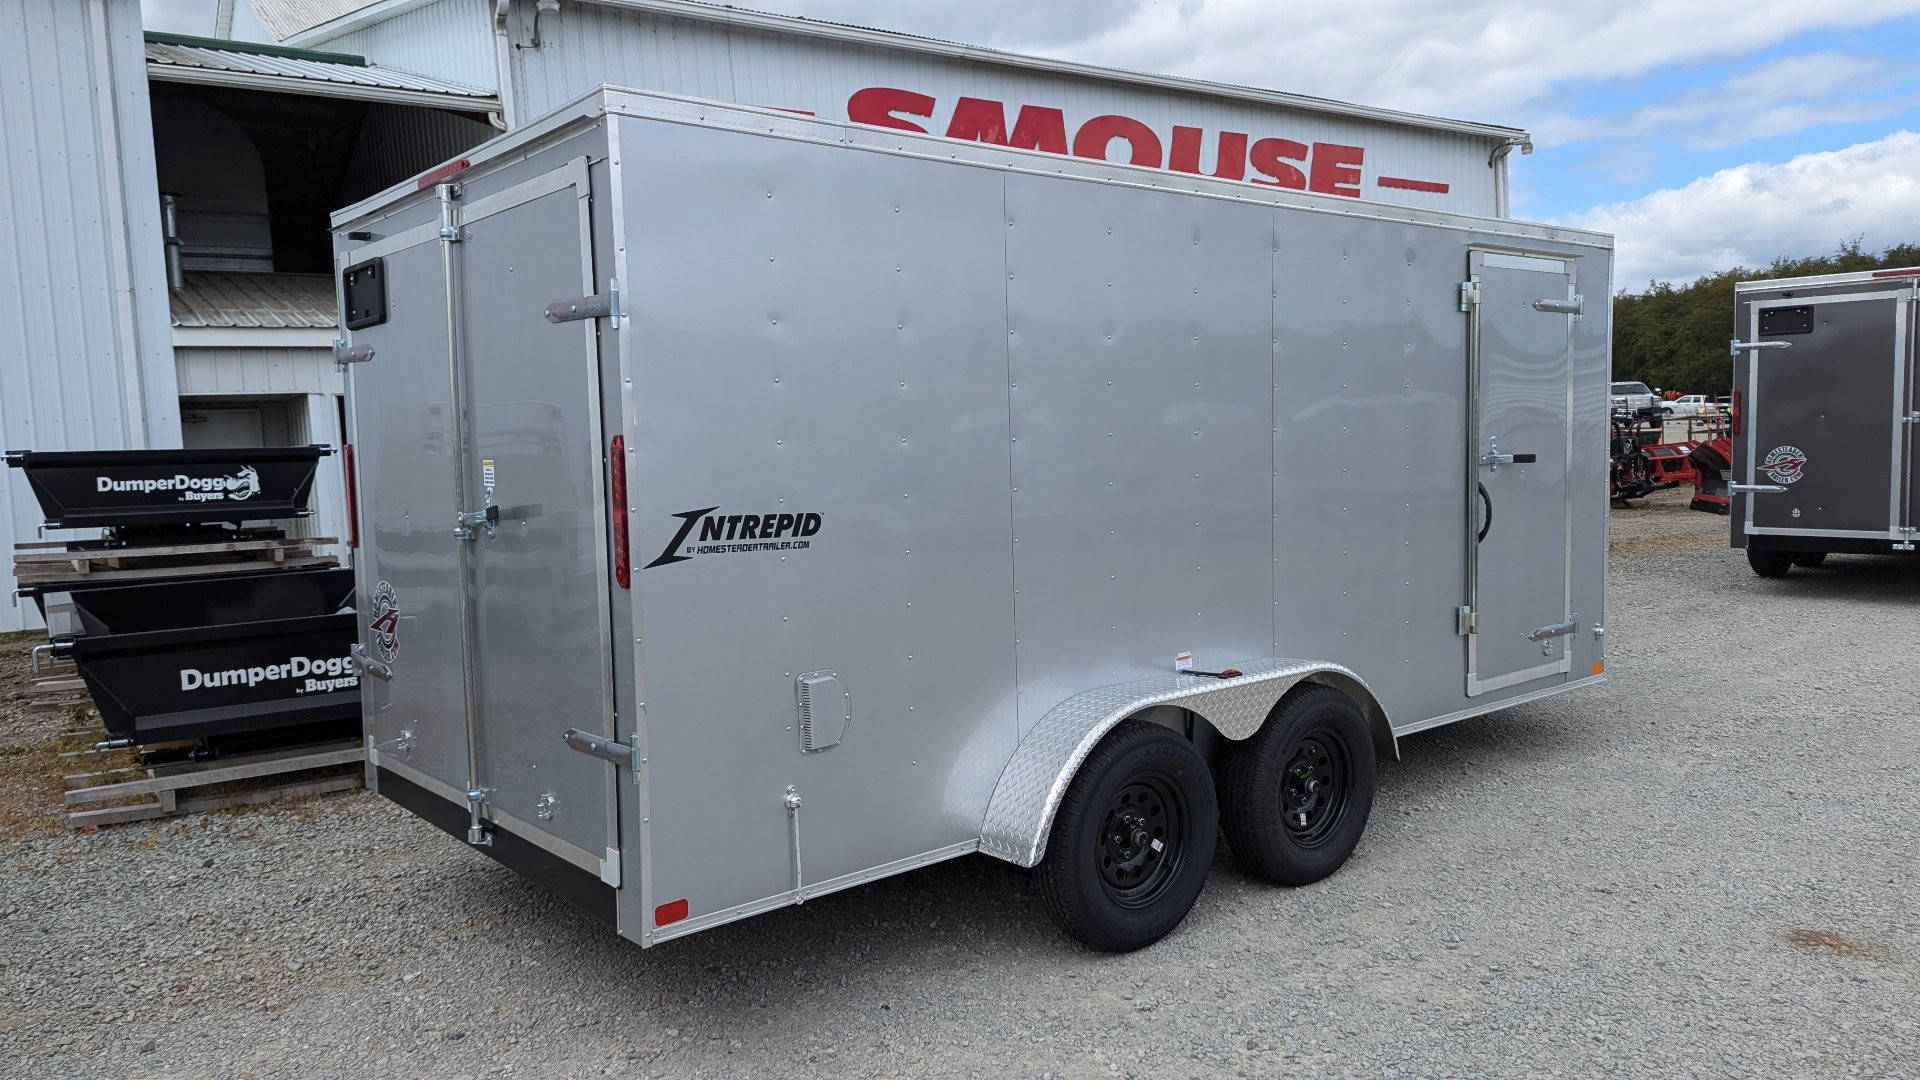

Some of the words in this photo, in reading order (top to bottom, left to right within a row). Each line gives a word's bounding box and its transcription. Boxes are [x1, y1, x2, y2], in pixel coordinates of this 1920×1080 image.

[848, 87, 1364, 198] SMOUSE
[97, 474, 224, 493] DumperDogg
[185, 491, 224, 502] Buyers
[643, 506, 822, 569] INTREPID
[686, 546, 696, 554] BY
[697, 541, 810, 554] HOMESTEADERTRAILER.COM
[305, 676, 358, 692] Buyers
